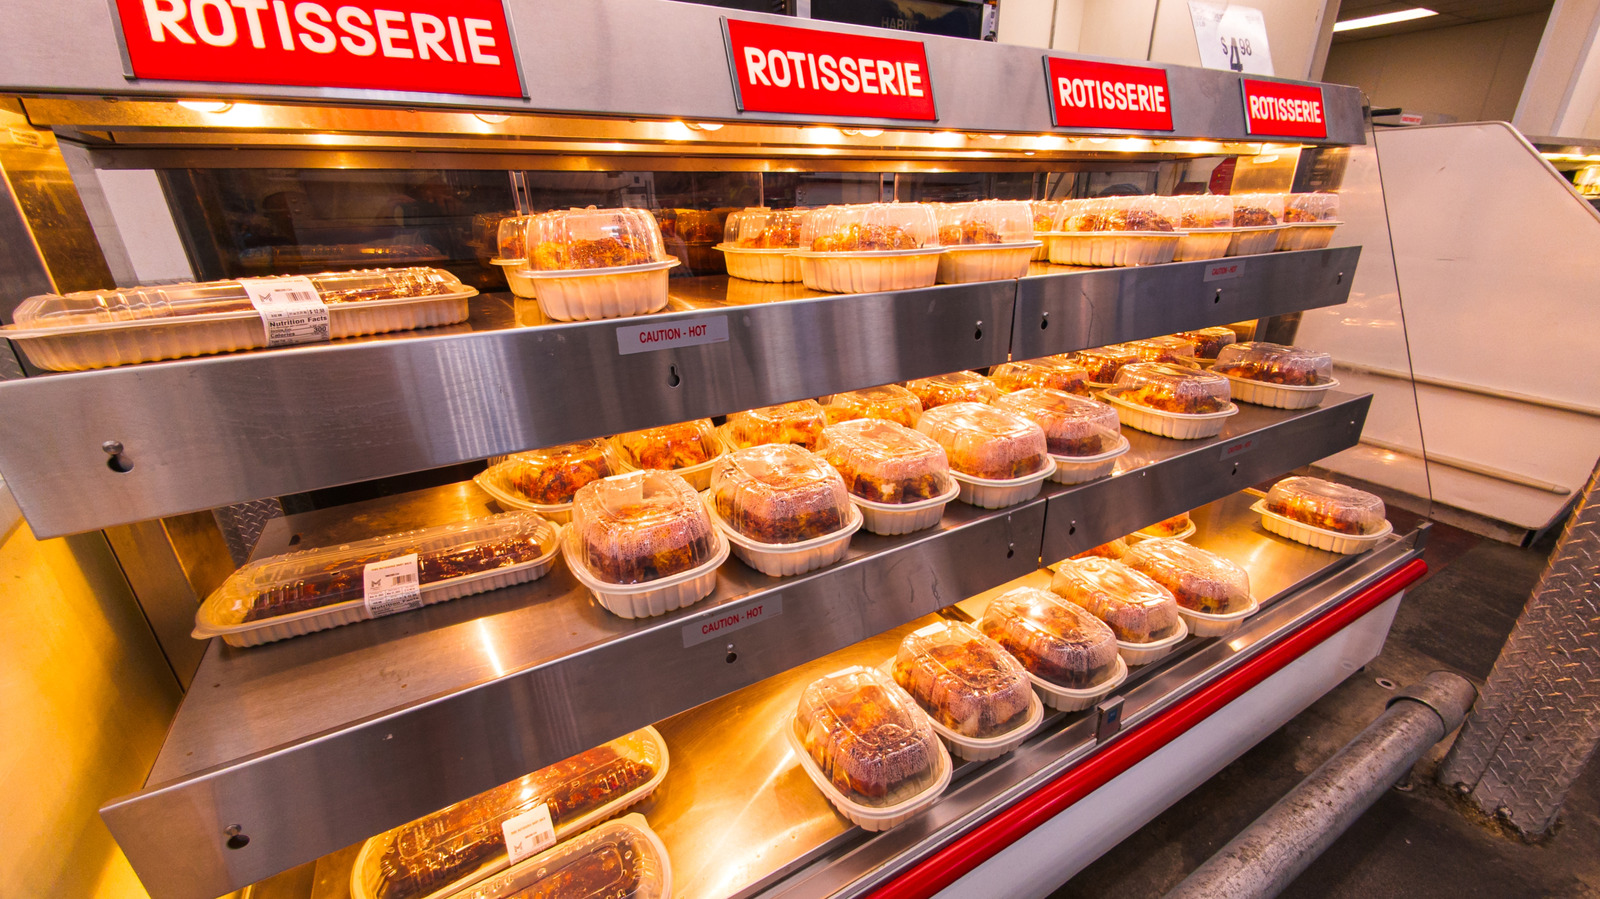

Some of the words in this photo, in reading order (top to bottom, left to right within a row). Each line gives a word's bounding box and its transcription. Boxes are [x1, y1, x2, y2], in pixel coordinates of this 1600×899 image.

[144, 0, 500, 65] ROTISSERIE
[743, 46, 924, 98] ROTISSERIE
[1057, 77, 1167, 113] ROTISSERIE
[1249, 95, 1322, 124] ROTISSERIE
[270, 319, 305, 327] Nutrition
[639, 327, 681, 344] CAUTION
[688, 324, 707, 338] HOT
[701, 613, 740, 635] CAUTION
[746, 605, 764, 620] HOT
